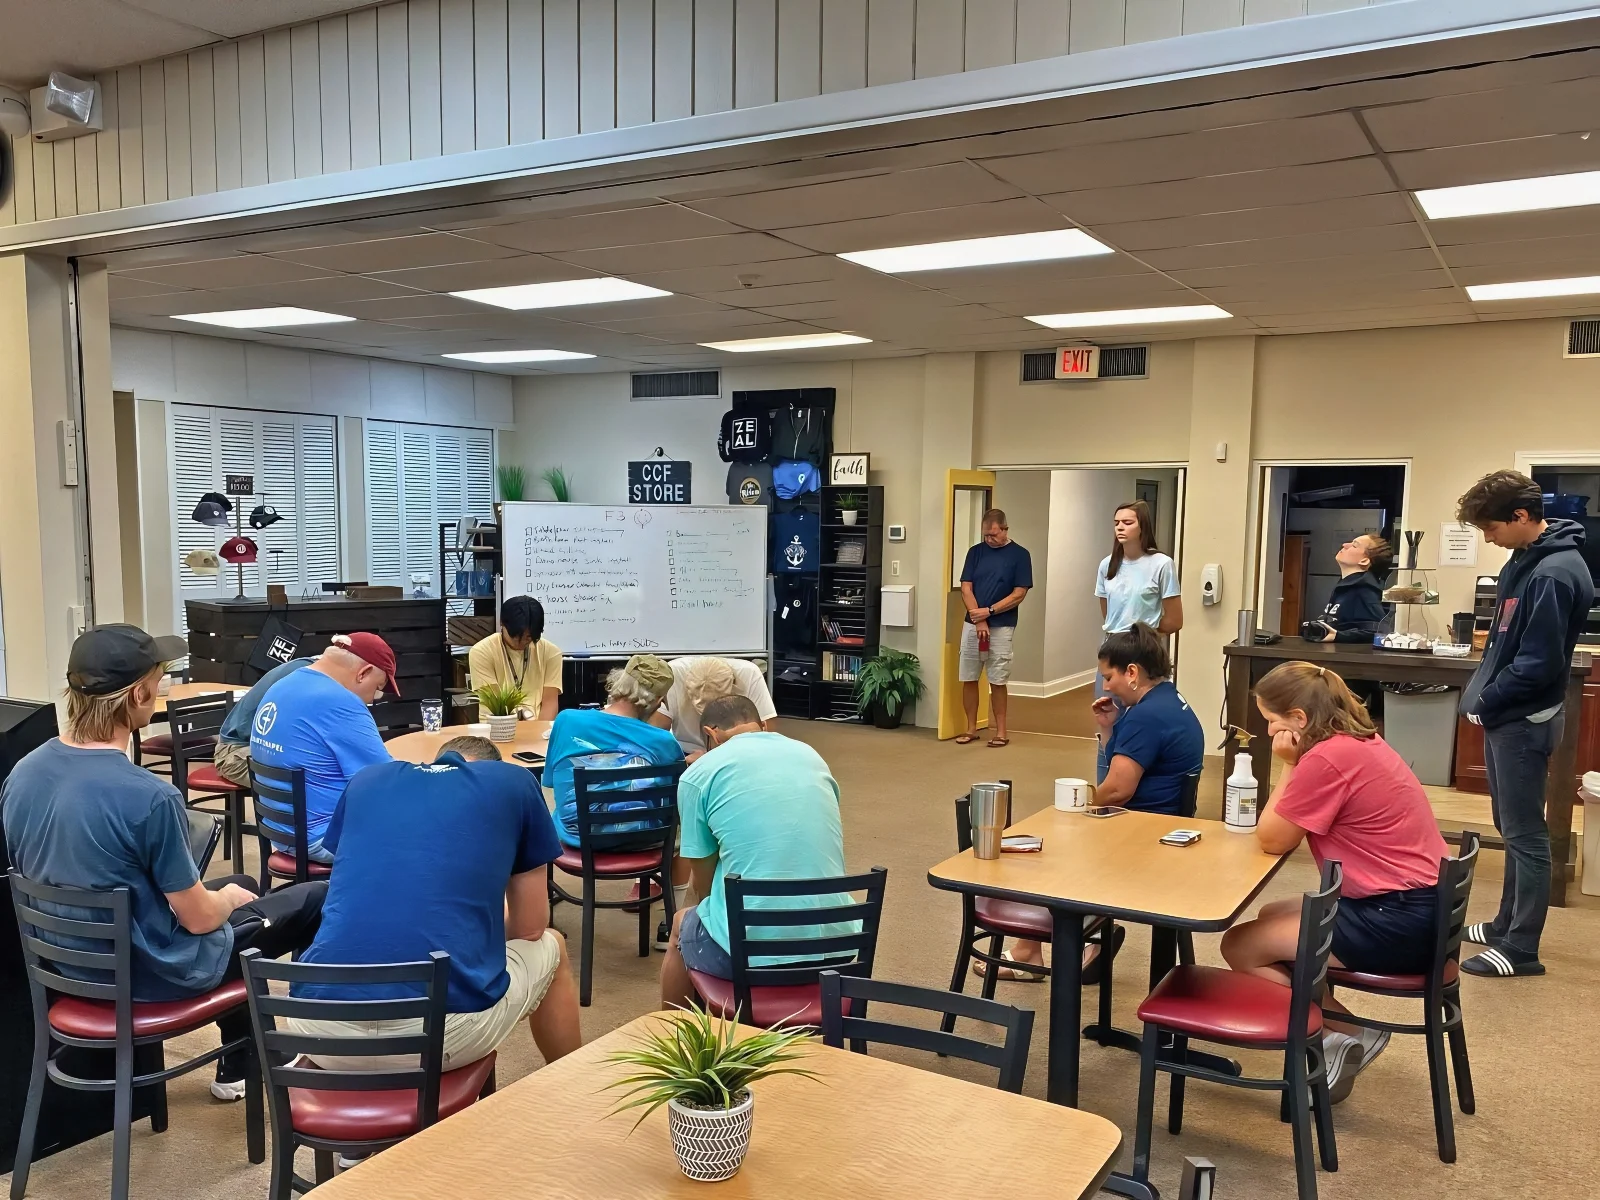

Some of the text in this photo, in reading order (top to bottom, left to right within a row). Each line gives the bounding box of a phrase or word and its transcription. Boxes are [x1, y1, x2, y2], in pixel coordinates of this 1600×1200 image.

[1062, 350, 1093, 373] EXIT
[735, 420, 755, 433] ZE
[734, 433, 755, 447] AL
[642, 464, 672, 482] CCF
[833, 458, 865, 481] faith
[633, 484, 684, 502] STORE
[1070, 788, 1085, 808] L
